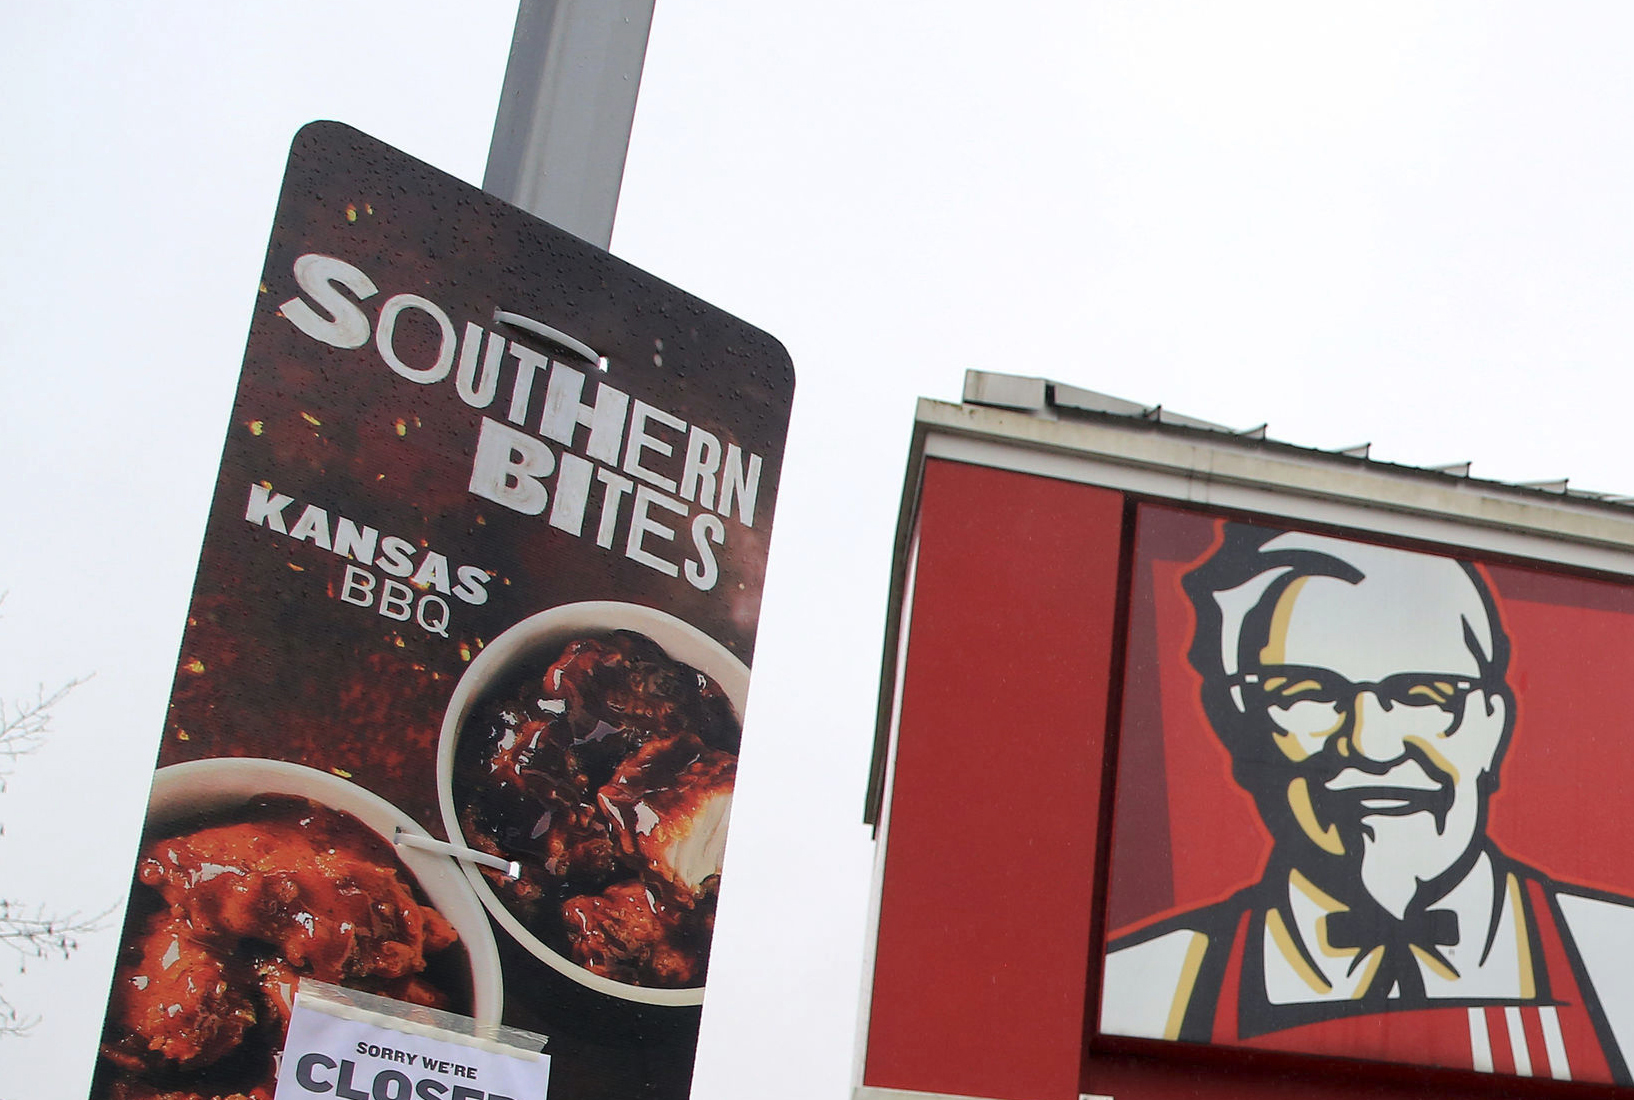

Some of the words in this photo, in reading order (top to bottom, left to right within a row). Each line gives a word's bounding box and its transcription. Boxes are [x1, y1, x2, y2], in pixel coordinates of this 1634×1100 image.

[279, 253, 763, 528] SOUTHERN
[245, 485, 491, 606] KANSAS
[468, 416, 725, 591] BITES
[340, 564, 451, 639] BBQ
[356, 1042, 418, 1065] SORRY
[422, 1056, 478, 1080] WE'RE
